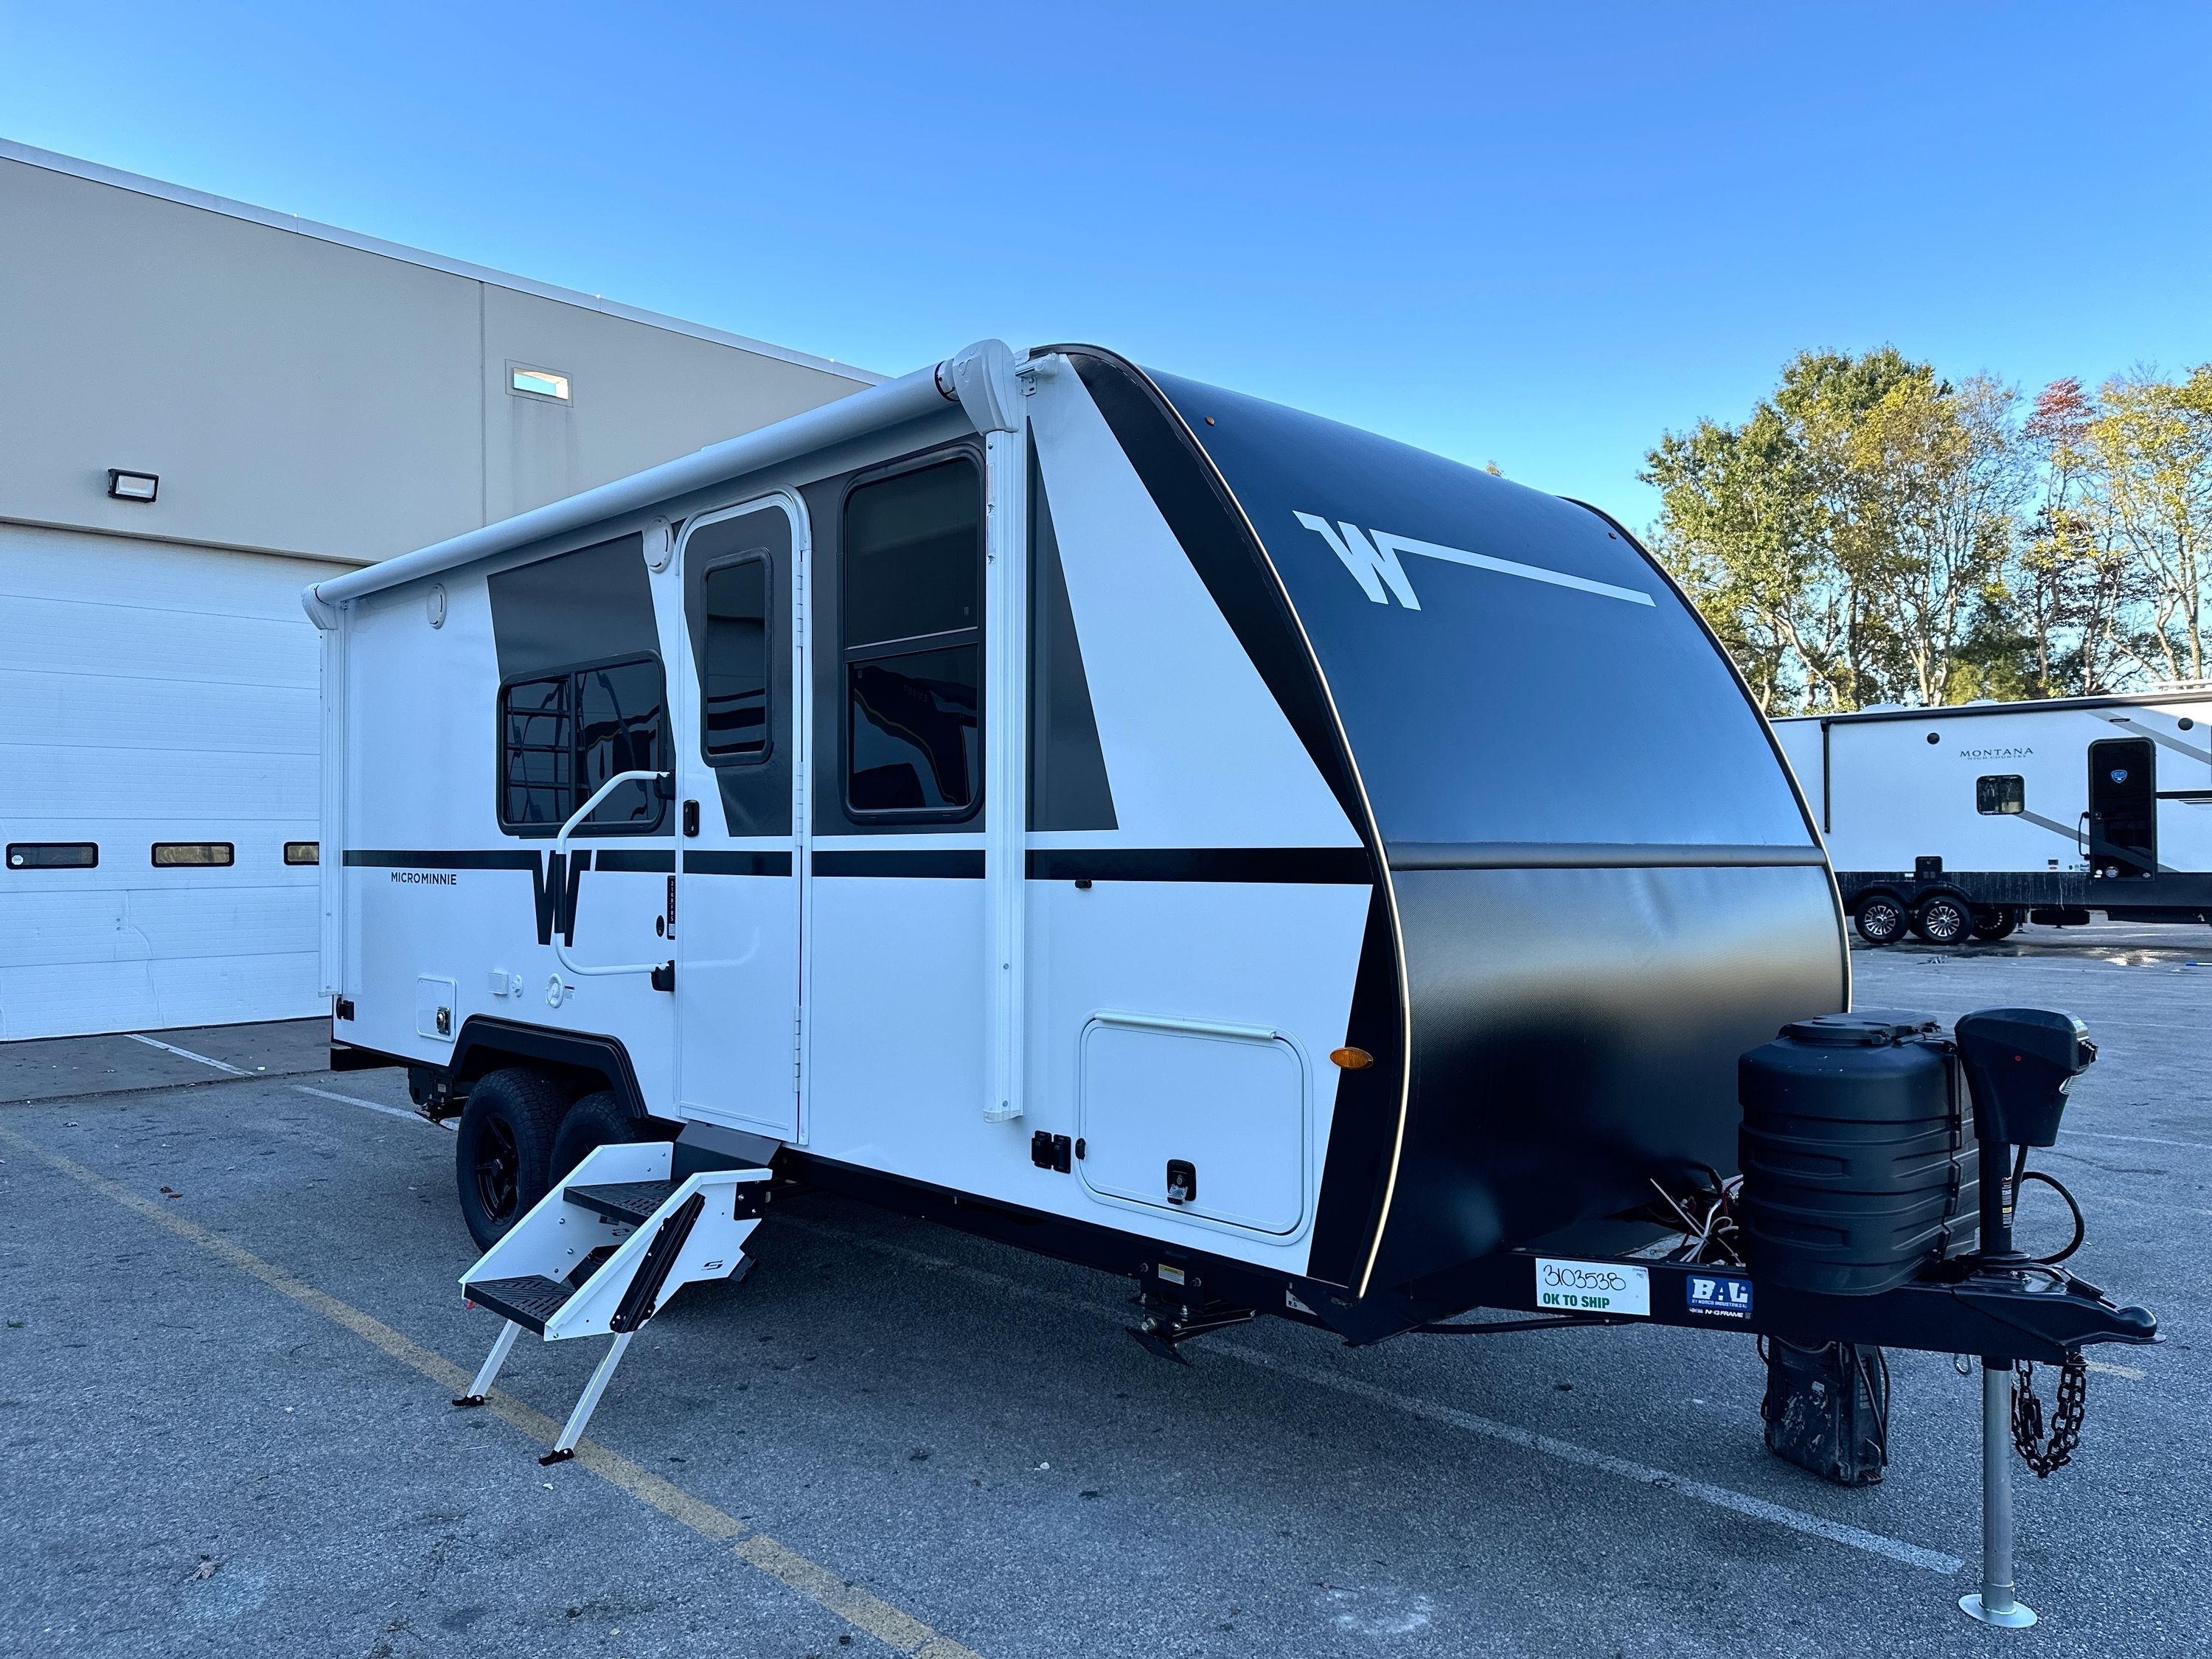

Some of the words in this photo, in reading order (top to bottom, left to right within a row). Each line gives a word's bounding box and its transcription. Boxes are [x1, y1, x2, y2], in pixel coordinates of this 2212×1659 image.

[1960, 748, 2034, 758] MONTANA
[391, 872, 457, 886] MICROMINNIE
[1543, 1265, 1627, 1291] 3103538
[1692, 1279, 1748, 1303] BAL
[1543, 1293, 1560, 1305] OK
[1562, 1294, 1578, 1306] TO
[1581, 1295, 1610, 1309] SHIP
